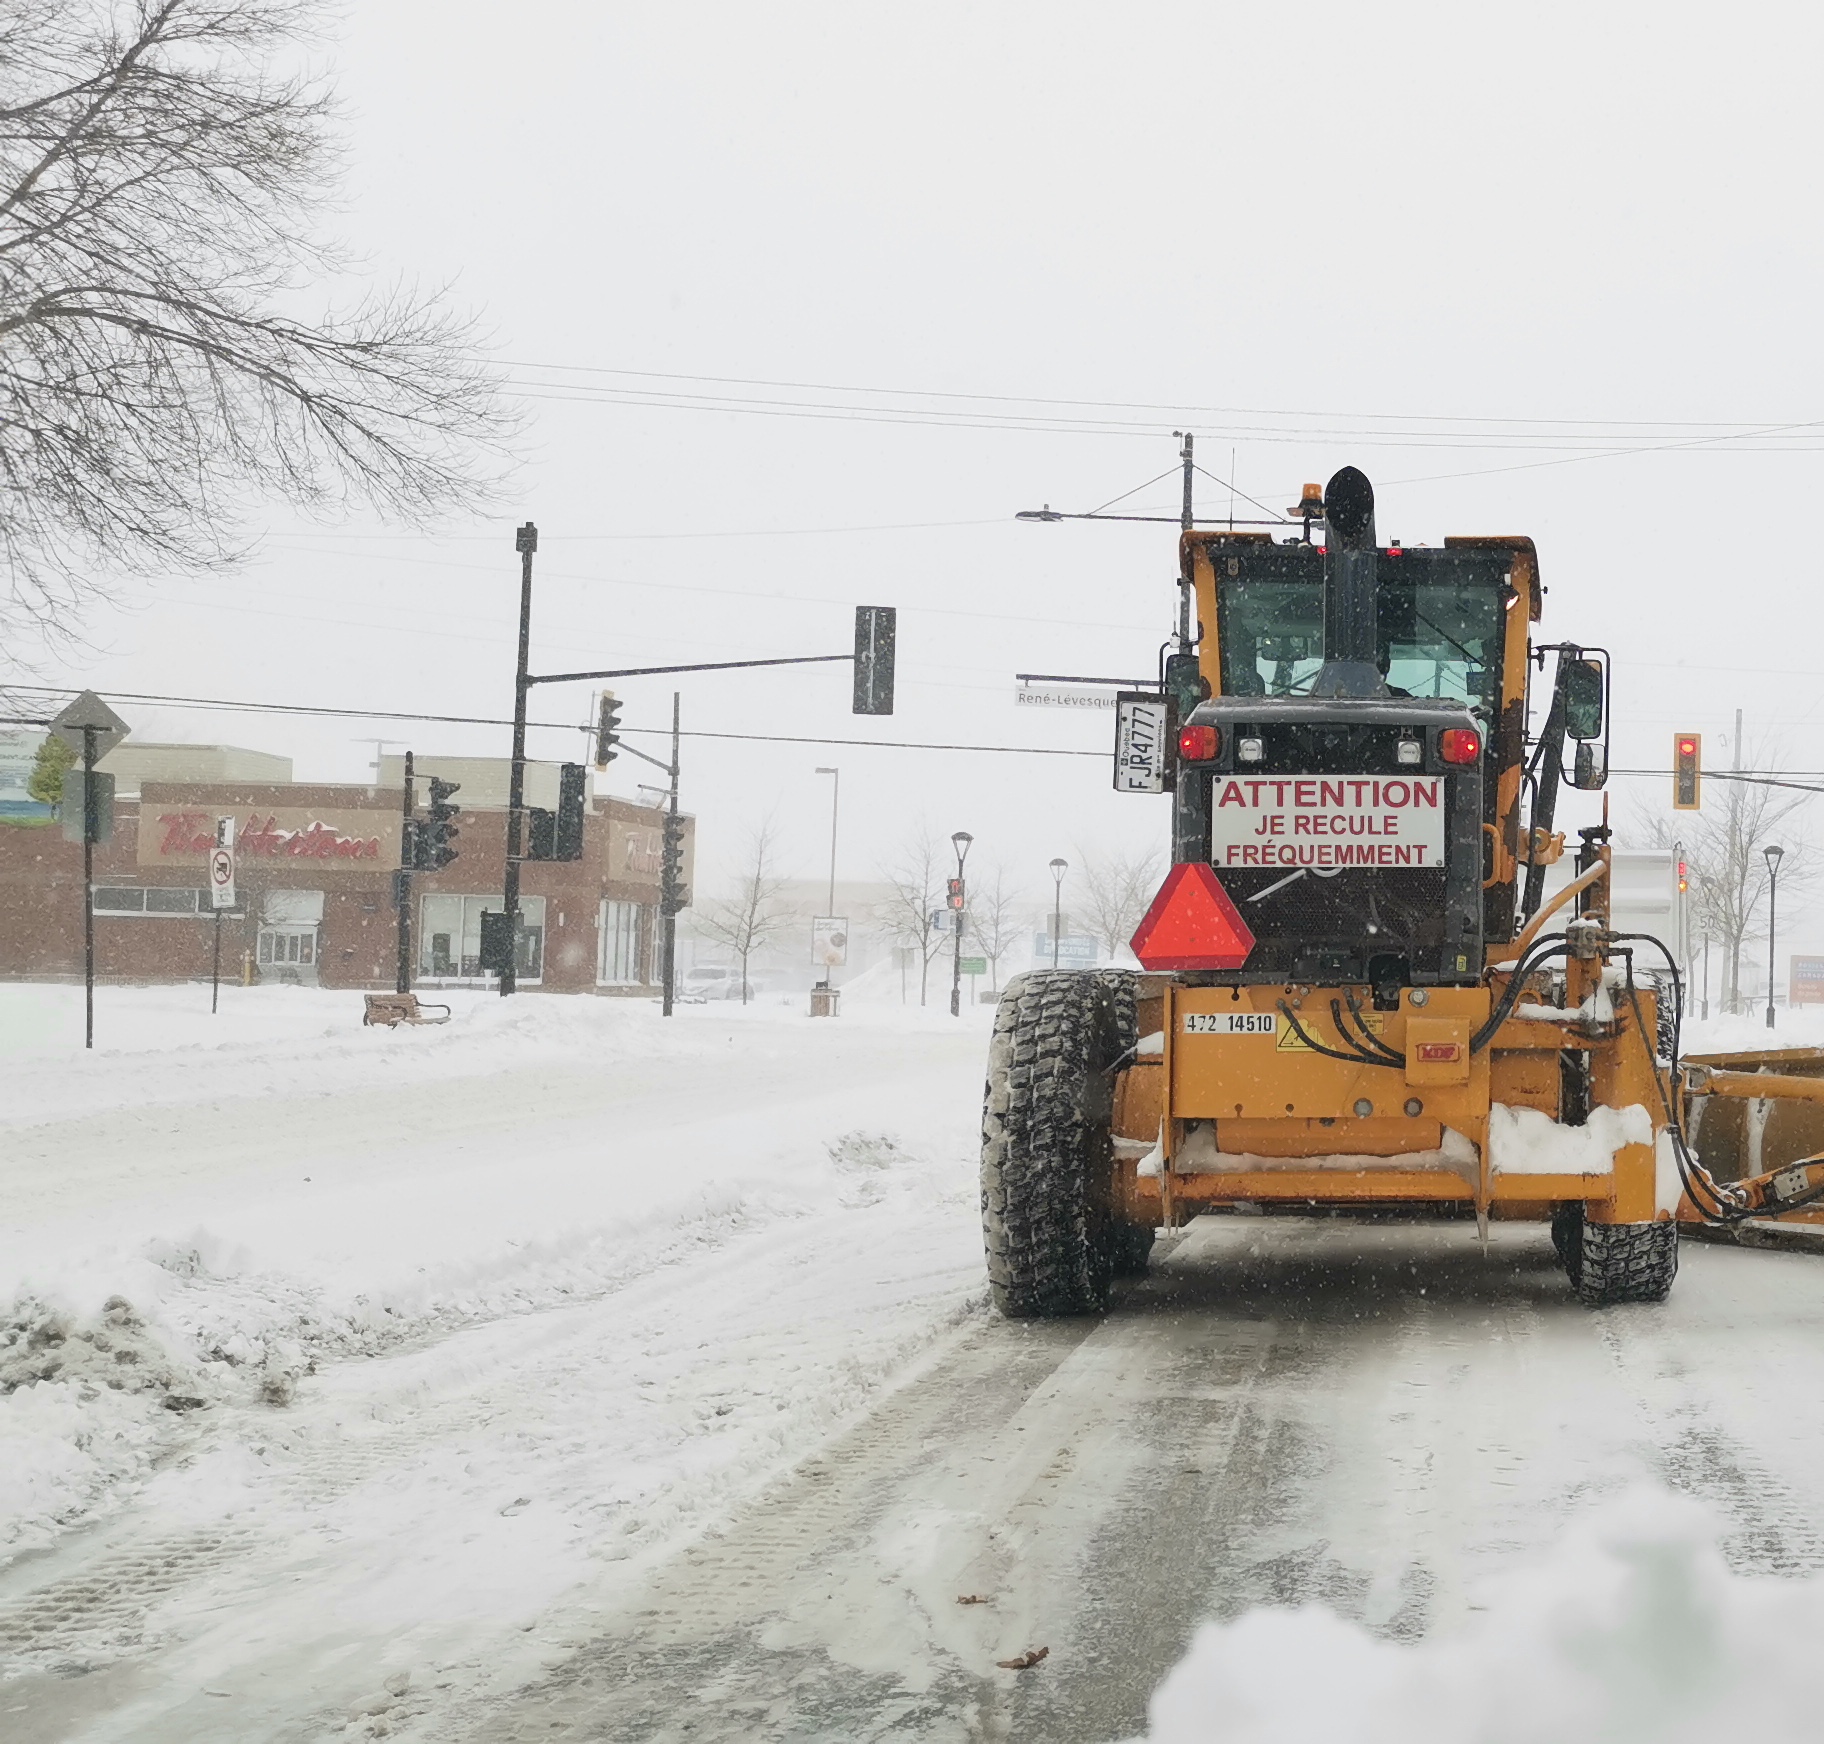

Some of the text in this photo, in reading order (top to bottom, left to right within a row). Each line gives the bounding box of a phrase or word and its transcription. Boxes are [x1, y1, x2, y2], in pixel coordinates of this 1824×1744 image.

[1018, 693, 1117, 708] René-Lévesque
[1128, 706, 1155, 789] FJR4777
[1218, 780, 1438, 808] ATTENTION
[1254, 815, 1399, 836] JE RECULE
[1226, 839, 1428, 866] FRÉQUEMMENT
[1186, 1015, 1273, 1032] 472 14510
